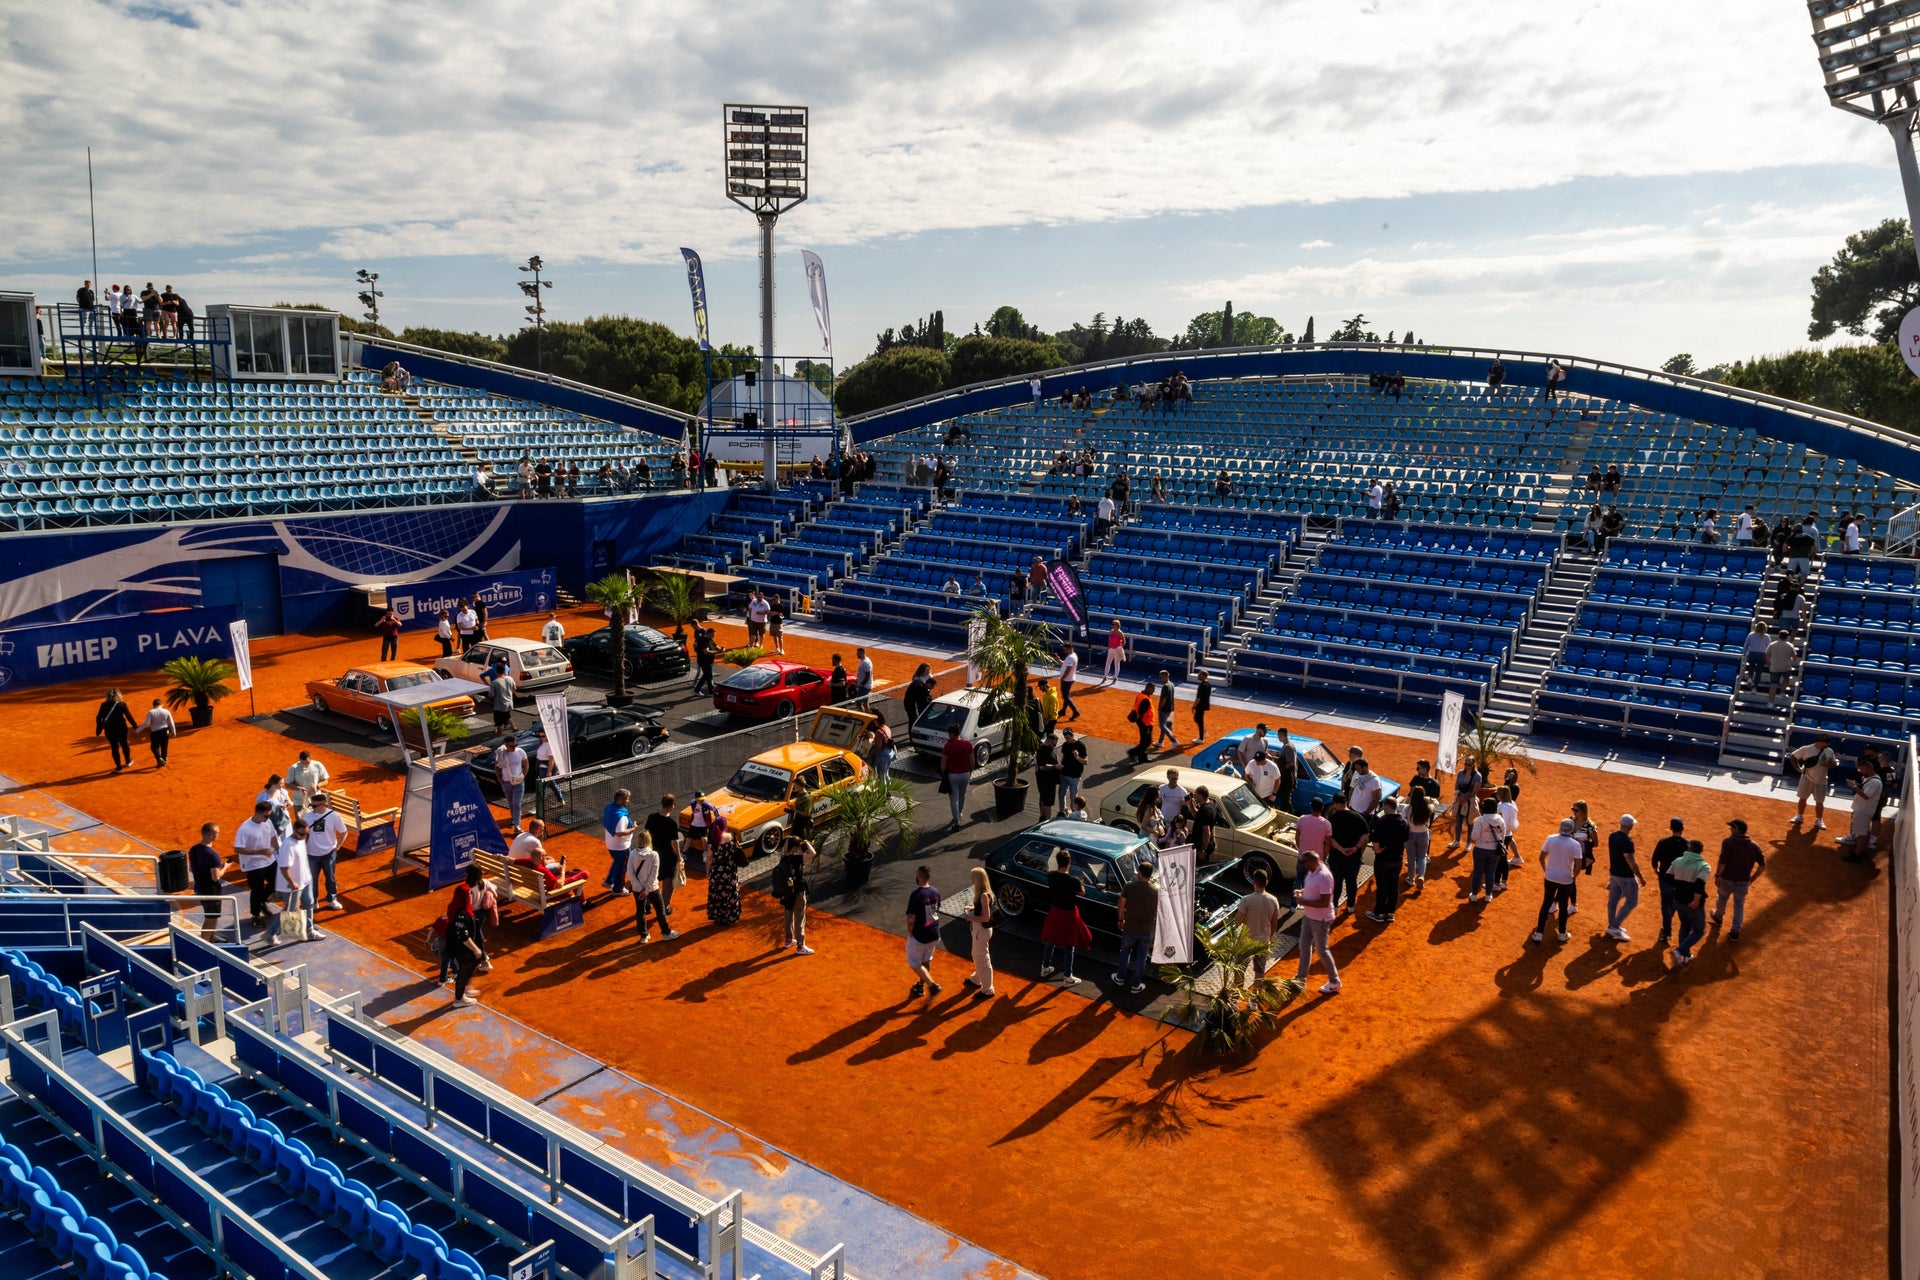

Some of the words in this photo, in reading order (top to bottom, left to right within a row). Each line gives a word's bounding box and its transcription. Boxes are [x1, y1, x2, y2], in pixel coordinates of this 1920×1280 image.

[482, 590, 520, 602] ODRAVKA
[417, 596, 460, 616] triglav
[65, 637, 118, 664] HEP
[138, 626, 222, 653] PLAVA
[89, 987, 96, 995] 3
[634, 1227, 640, 1237] 2
[520, 1269, 527, 1280] 3
